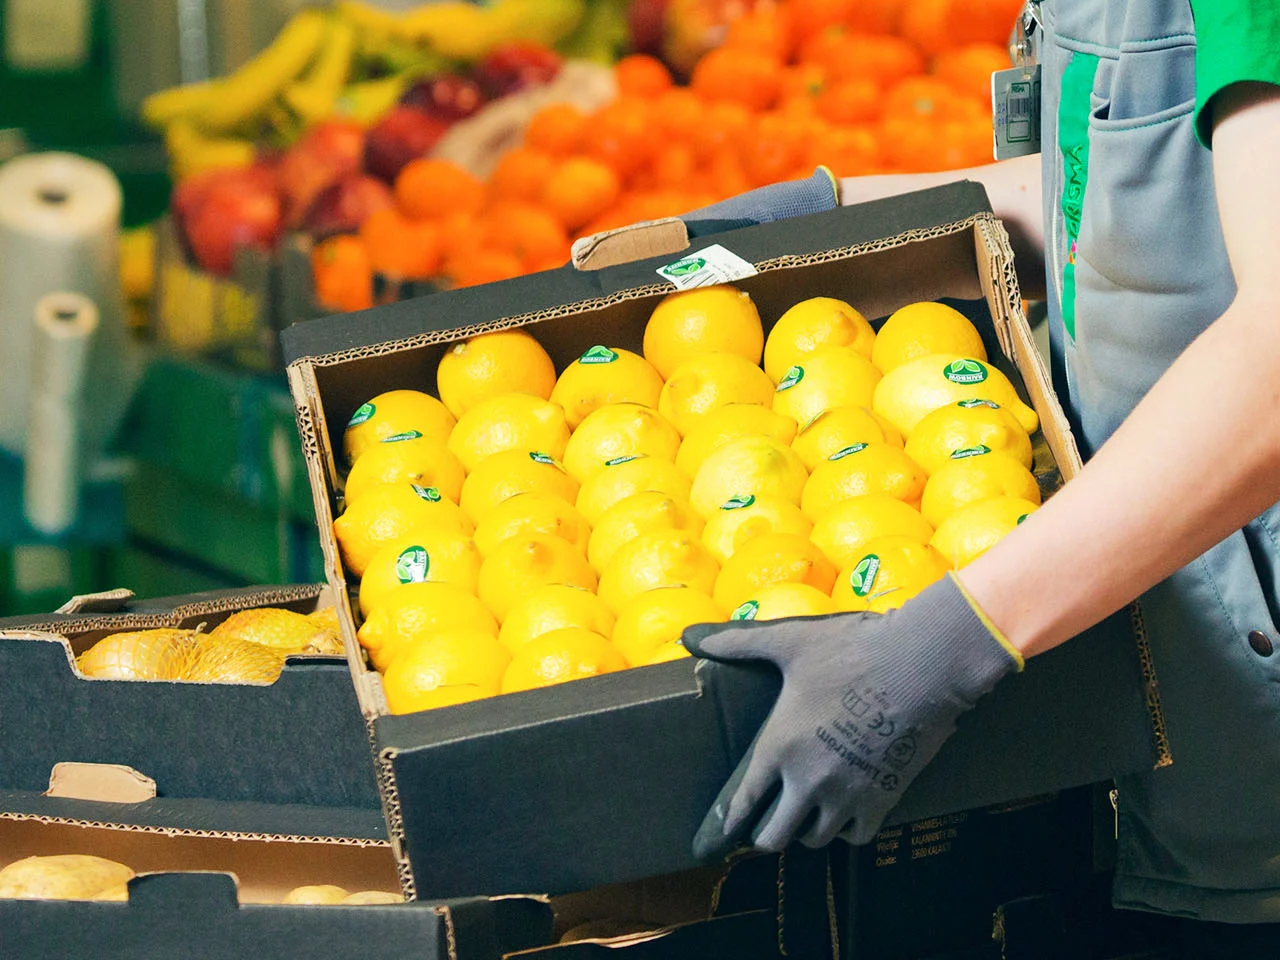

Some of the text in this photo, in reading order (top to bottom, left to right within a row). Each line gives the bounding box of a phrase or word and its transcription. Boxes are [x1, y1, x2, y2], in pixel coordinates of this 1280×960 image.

[1066, 143, 1083, 239] PRISMA
[948, 371, 984, 382] RAINBOW
[816, 726, 880, 780] Lindström
